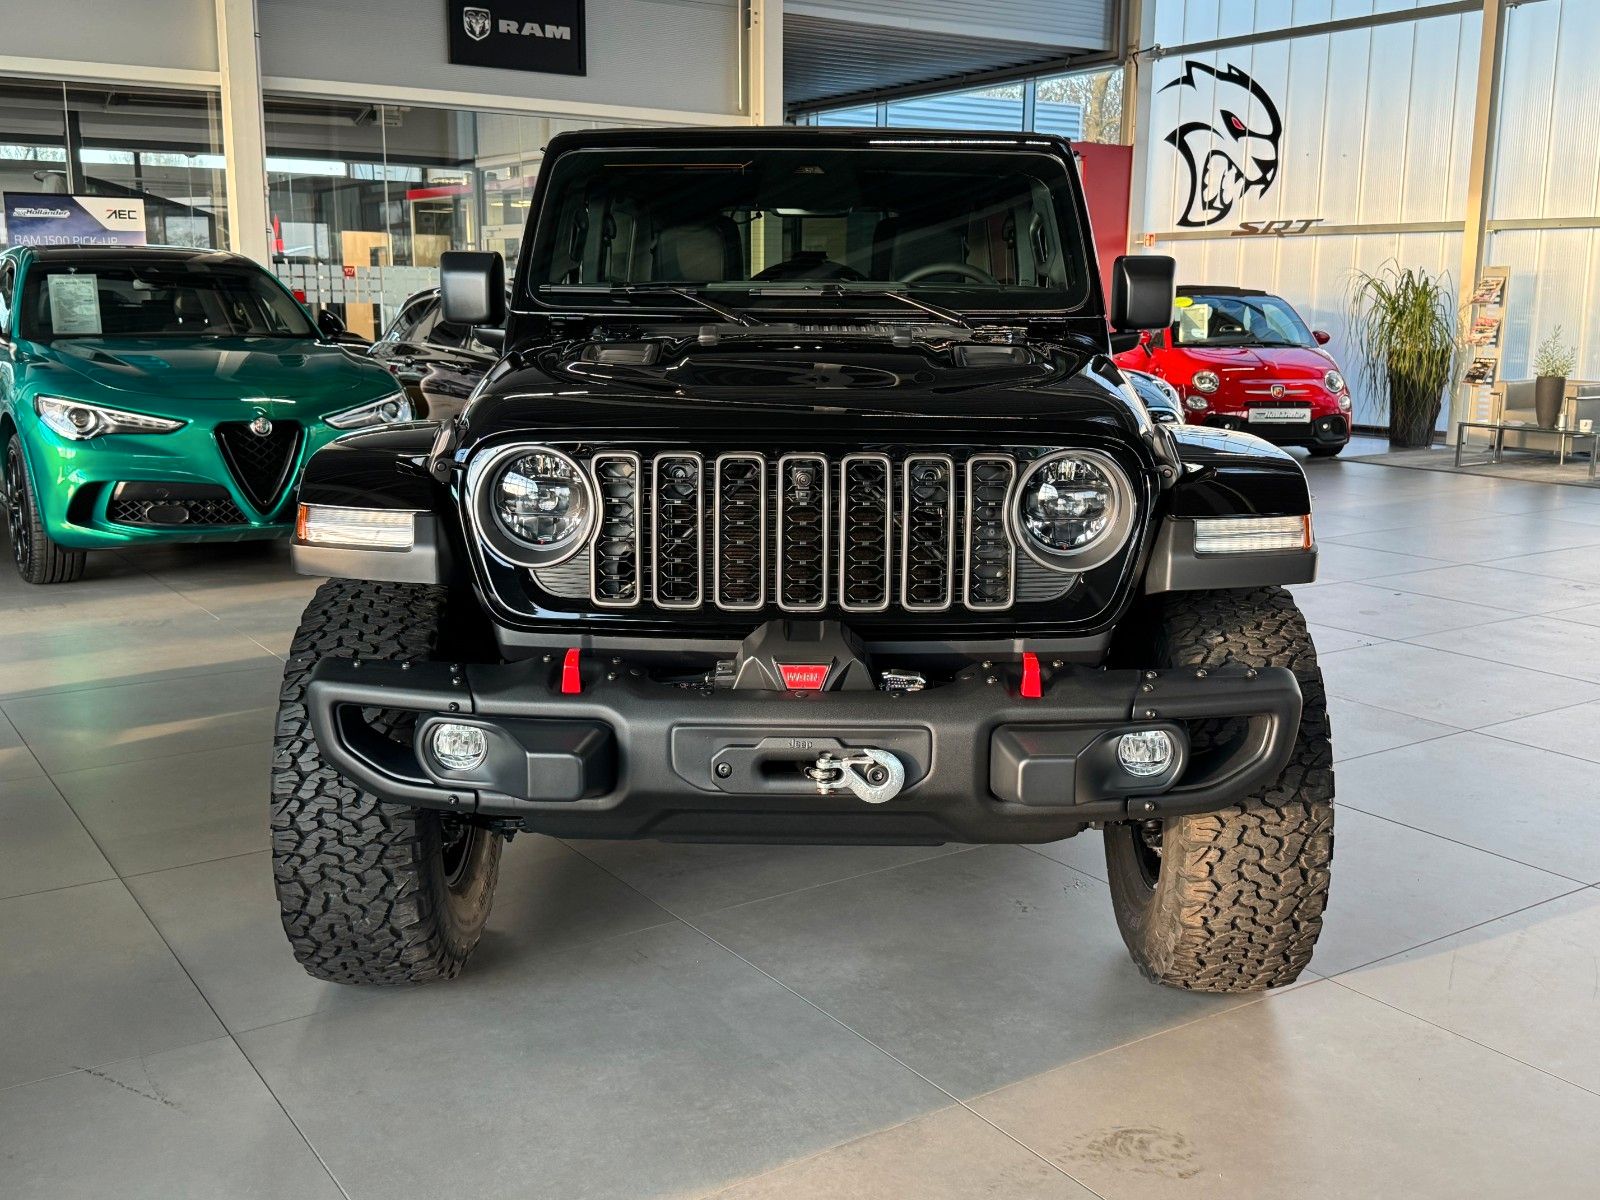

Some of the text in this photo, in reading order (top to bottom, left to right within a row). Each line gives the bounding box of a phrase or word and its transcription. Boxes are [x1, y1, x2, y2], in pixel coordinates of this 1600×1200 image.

[498, 19, 571, 40] RAM
[106, 209, 138, 220] AEC
[1231, 218, 1324, 238] SRT
[14, 234, 118, 245] RAM 1500 PICK-UP
[786, 671, 819, 682] WARN
[788, 738, 813, 750] Jeep
